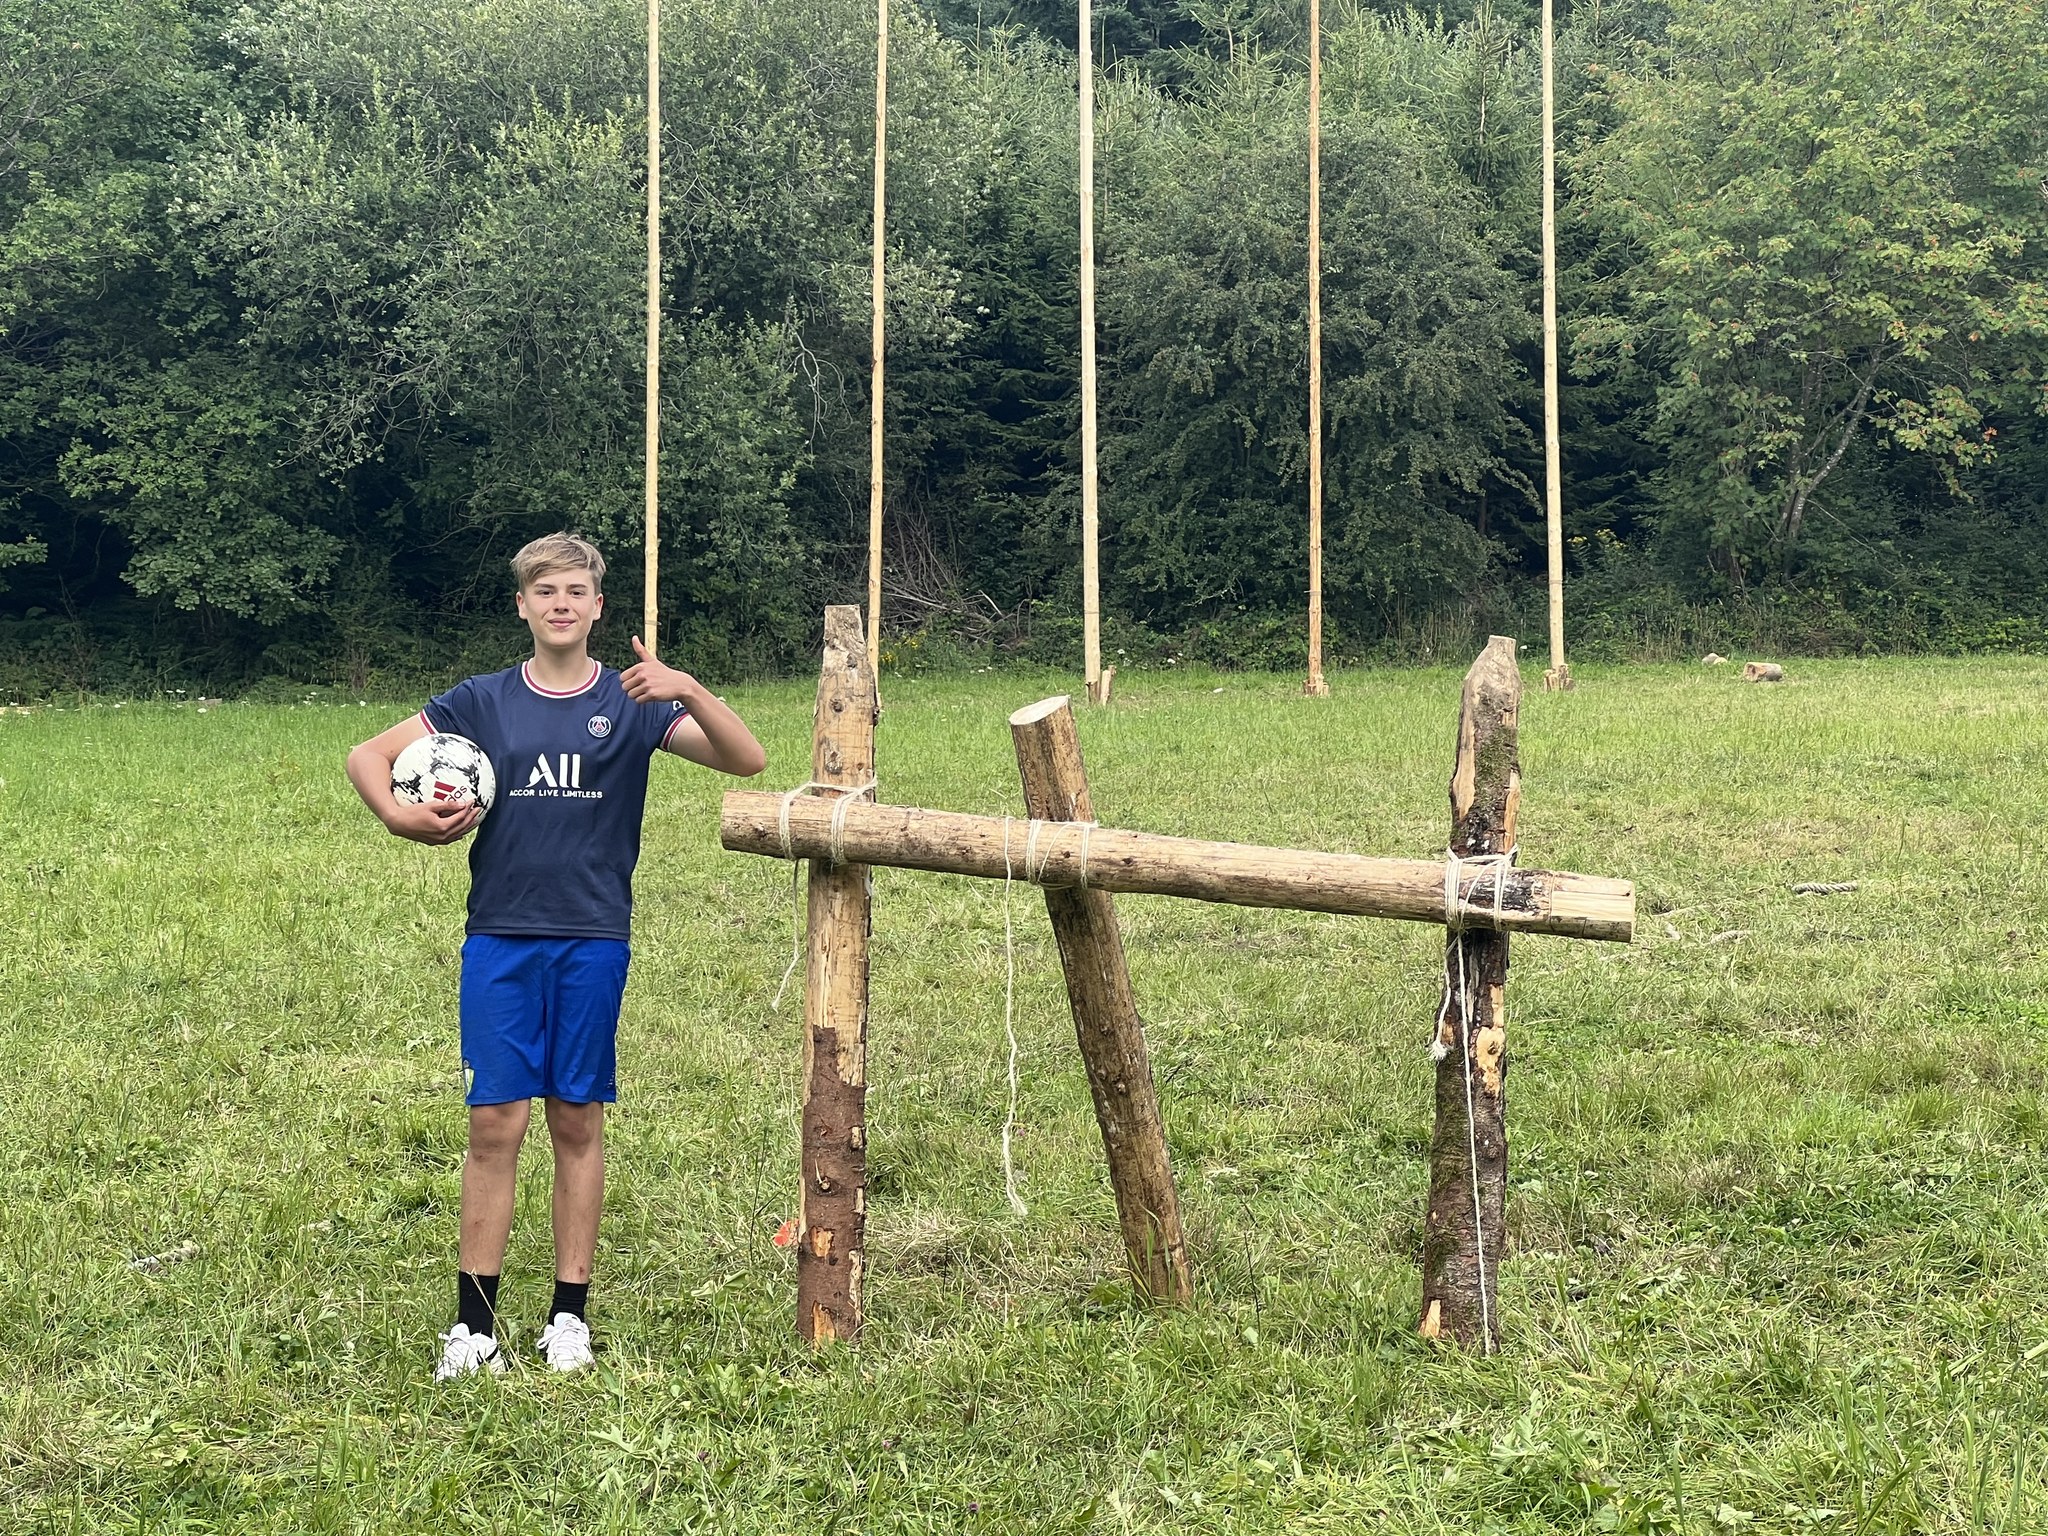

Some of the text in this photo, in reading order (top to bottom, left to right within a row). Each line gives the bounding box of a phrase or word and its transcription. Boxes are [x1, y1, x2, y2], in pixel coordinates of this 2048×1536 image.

[509, 788, 603, 799] ACCOR LIVE LIMITLESS
